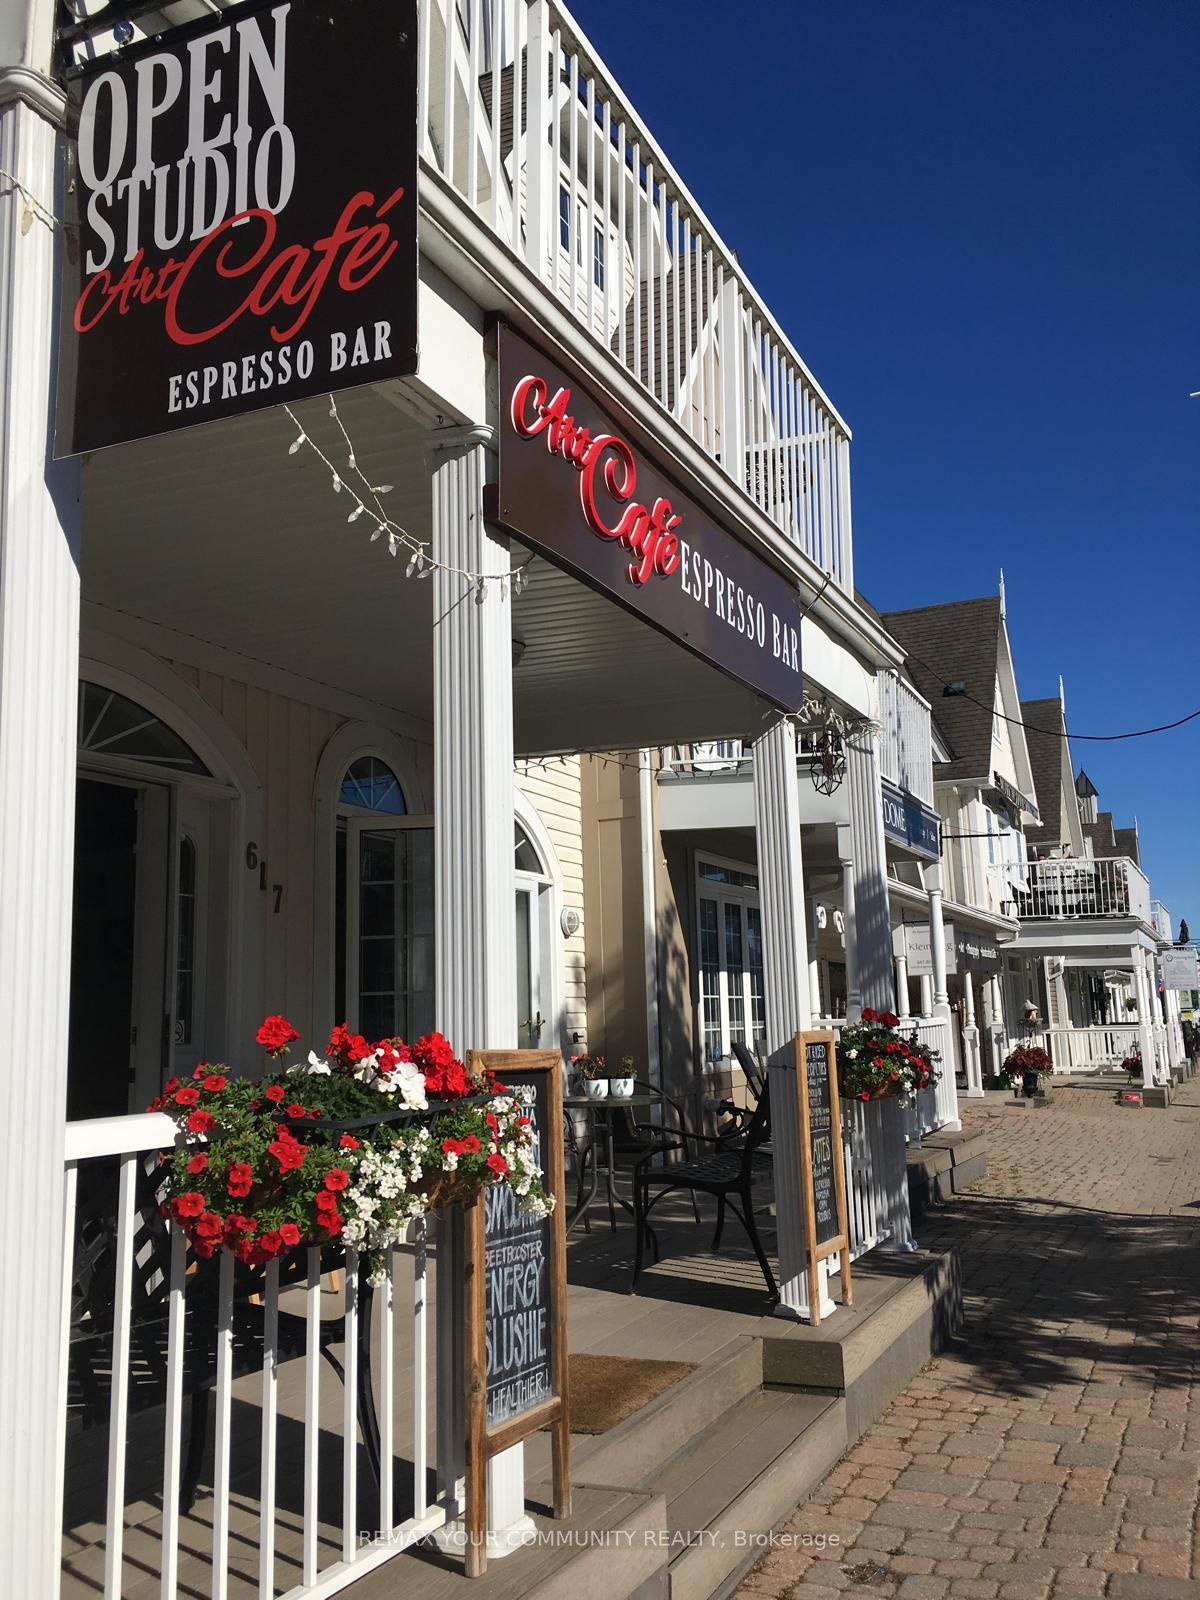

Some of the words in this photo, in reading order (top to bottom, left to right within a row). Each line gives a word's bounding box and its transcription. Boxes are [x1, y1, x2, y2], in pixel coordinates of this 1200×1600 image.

[78, 3, 292, 191] OPEN
[73, 248, 186, 332] Art
[165, 187, 404, 345] Café
[86, 124, 296, 274] STUDIO
[168, 341, 314, 413] ESPRESSO
[330, 321, 393, 372] BAR
[580, 434, 683, 585] Café
[680, 539, 766, 648] ESPRESSO
[772, 613, 800, 673] BAR
[246, 841, 283, 914] 617
[485, 1307, 546, 1376] SLUSHIE
